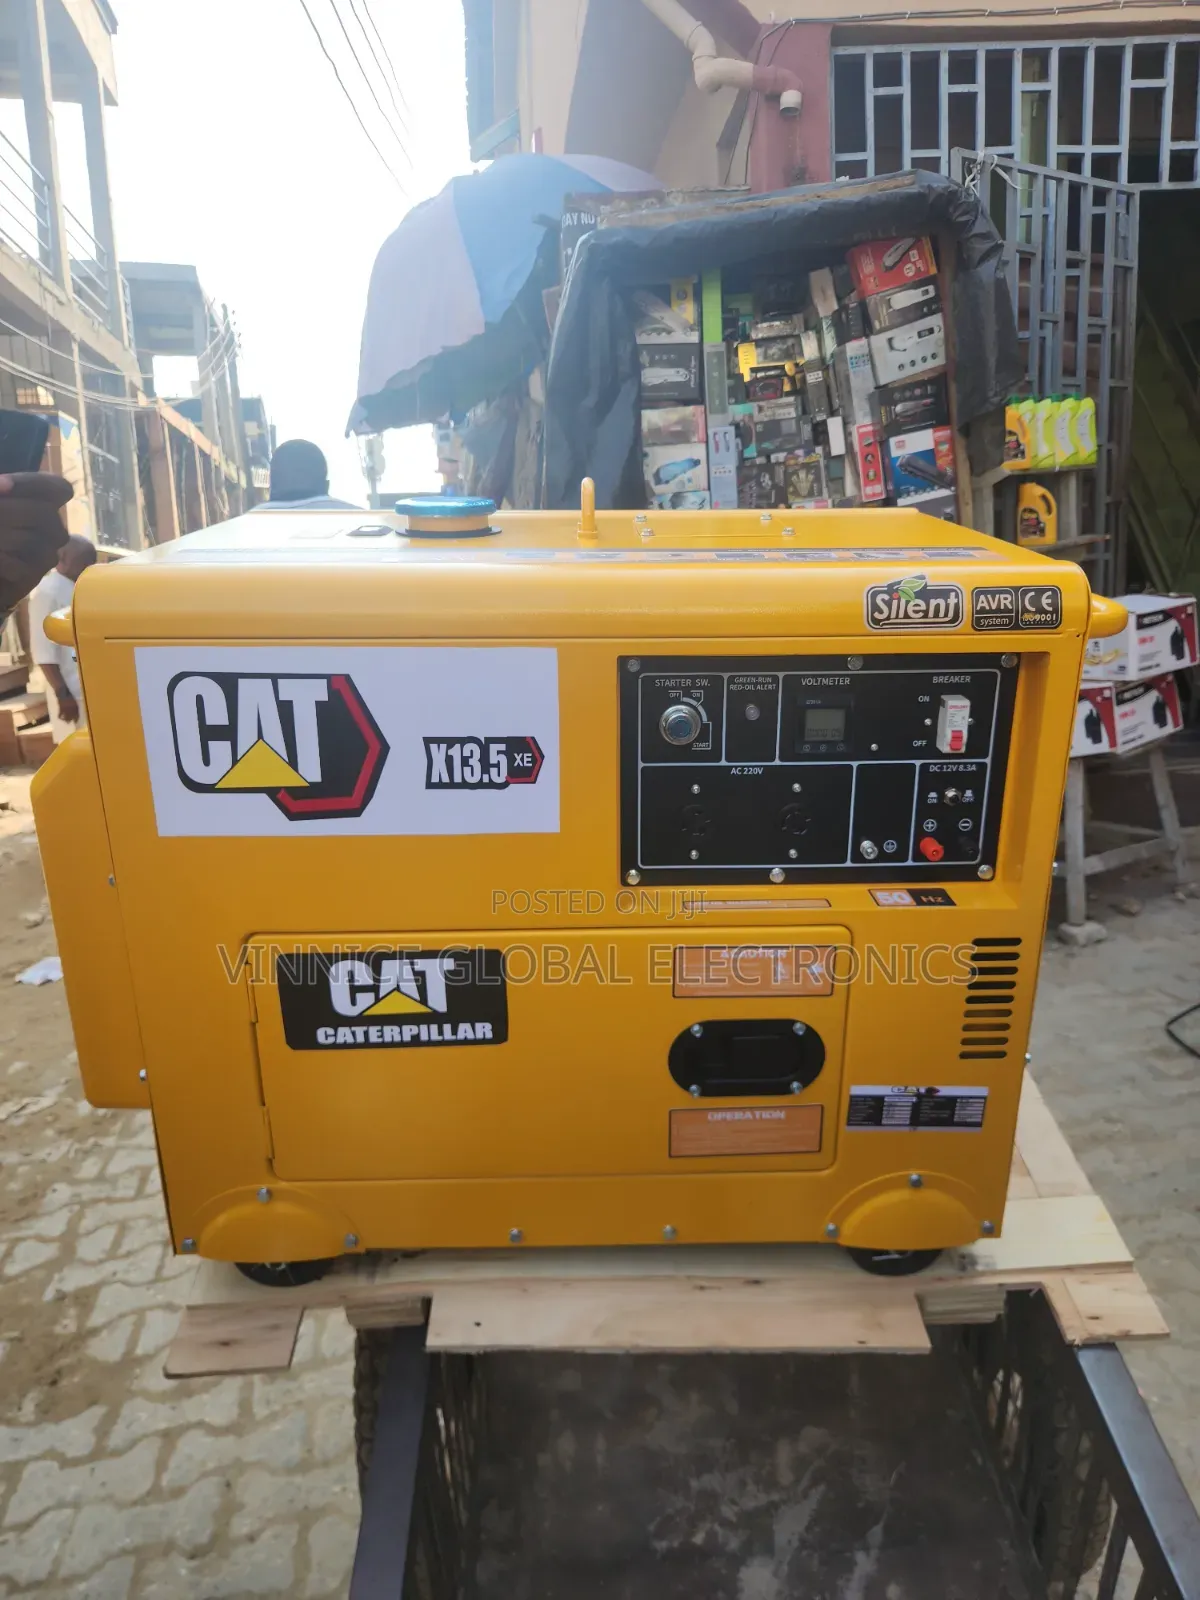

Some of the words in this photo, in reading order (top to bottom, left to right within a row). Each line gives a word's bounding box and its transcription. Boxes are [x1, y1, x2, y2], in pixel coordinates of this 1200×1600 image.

[874, 591, 959, 621] Silent
[976, 595, 1013, 611] AVR
[1024, 591, 1054, 611] CE
[980, 617, 1009, 626] system
[655, 679, 692, 687] STARTER
[695, 679, 711, 687] SW.
[801, 677, 850, 686] VOLTMETER
[932, 675, 971, 684] BREAKER
[173, 675, 329, 786] CAT
[430, 743, 508, 784] X13.5
[513, 753, 532, 767] XE
[958, 764, 977, 772] 8.3A
[730, 767, 742, 775] AC
[743, 767, 764, 775] 220V
[876, 892, 911, 904] 50
[920, 895, 945, 903] Hz
[328, 957, 455, 1017] CAT
[316, 1022, 493, 1044] CATERPILLAR
[707, 1110, 786, 1121] OPERATION
